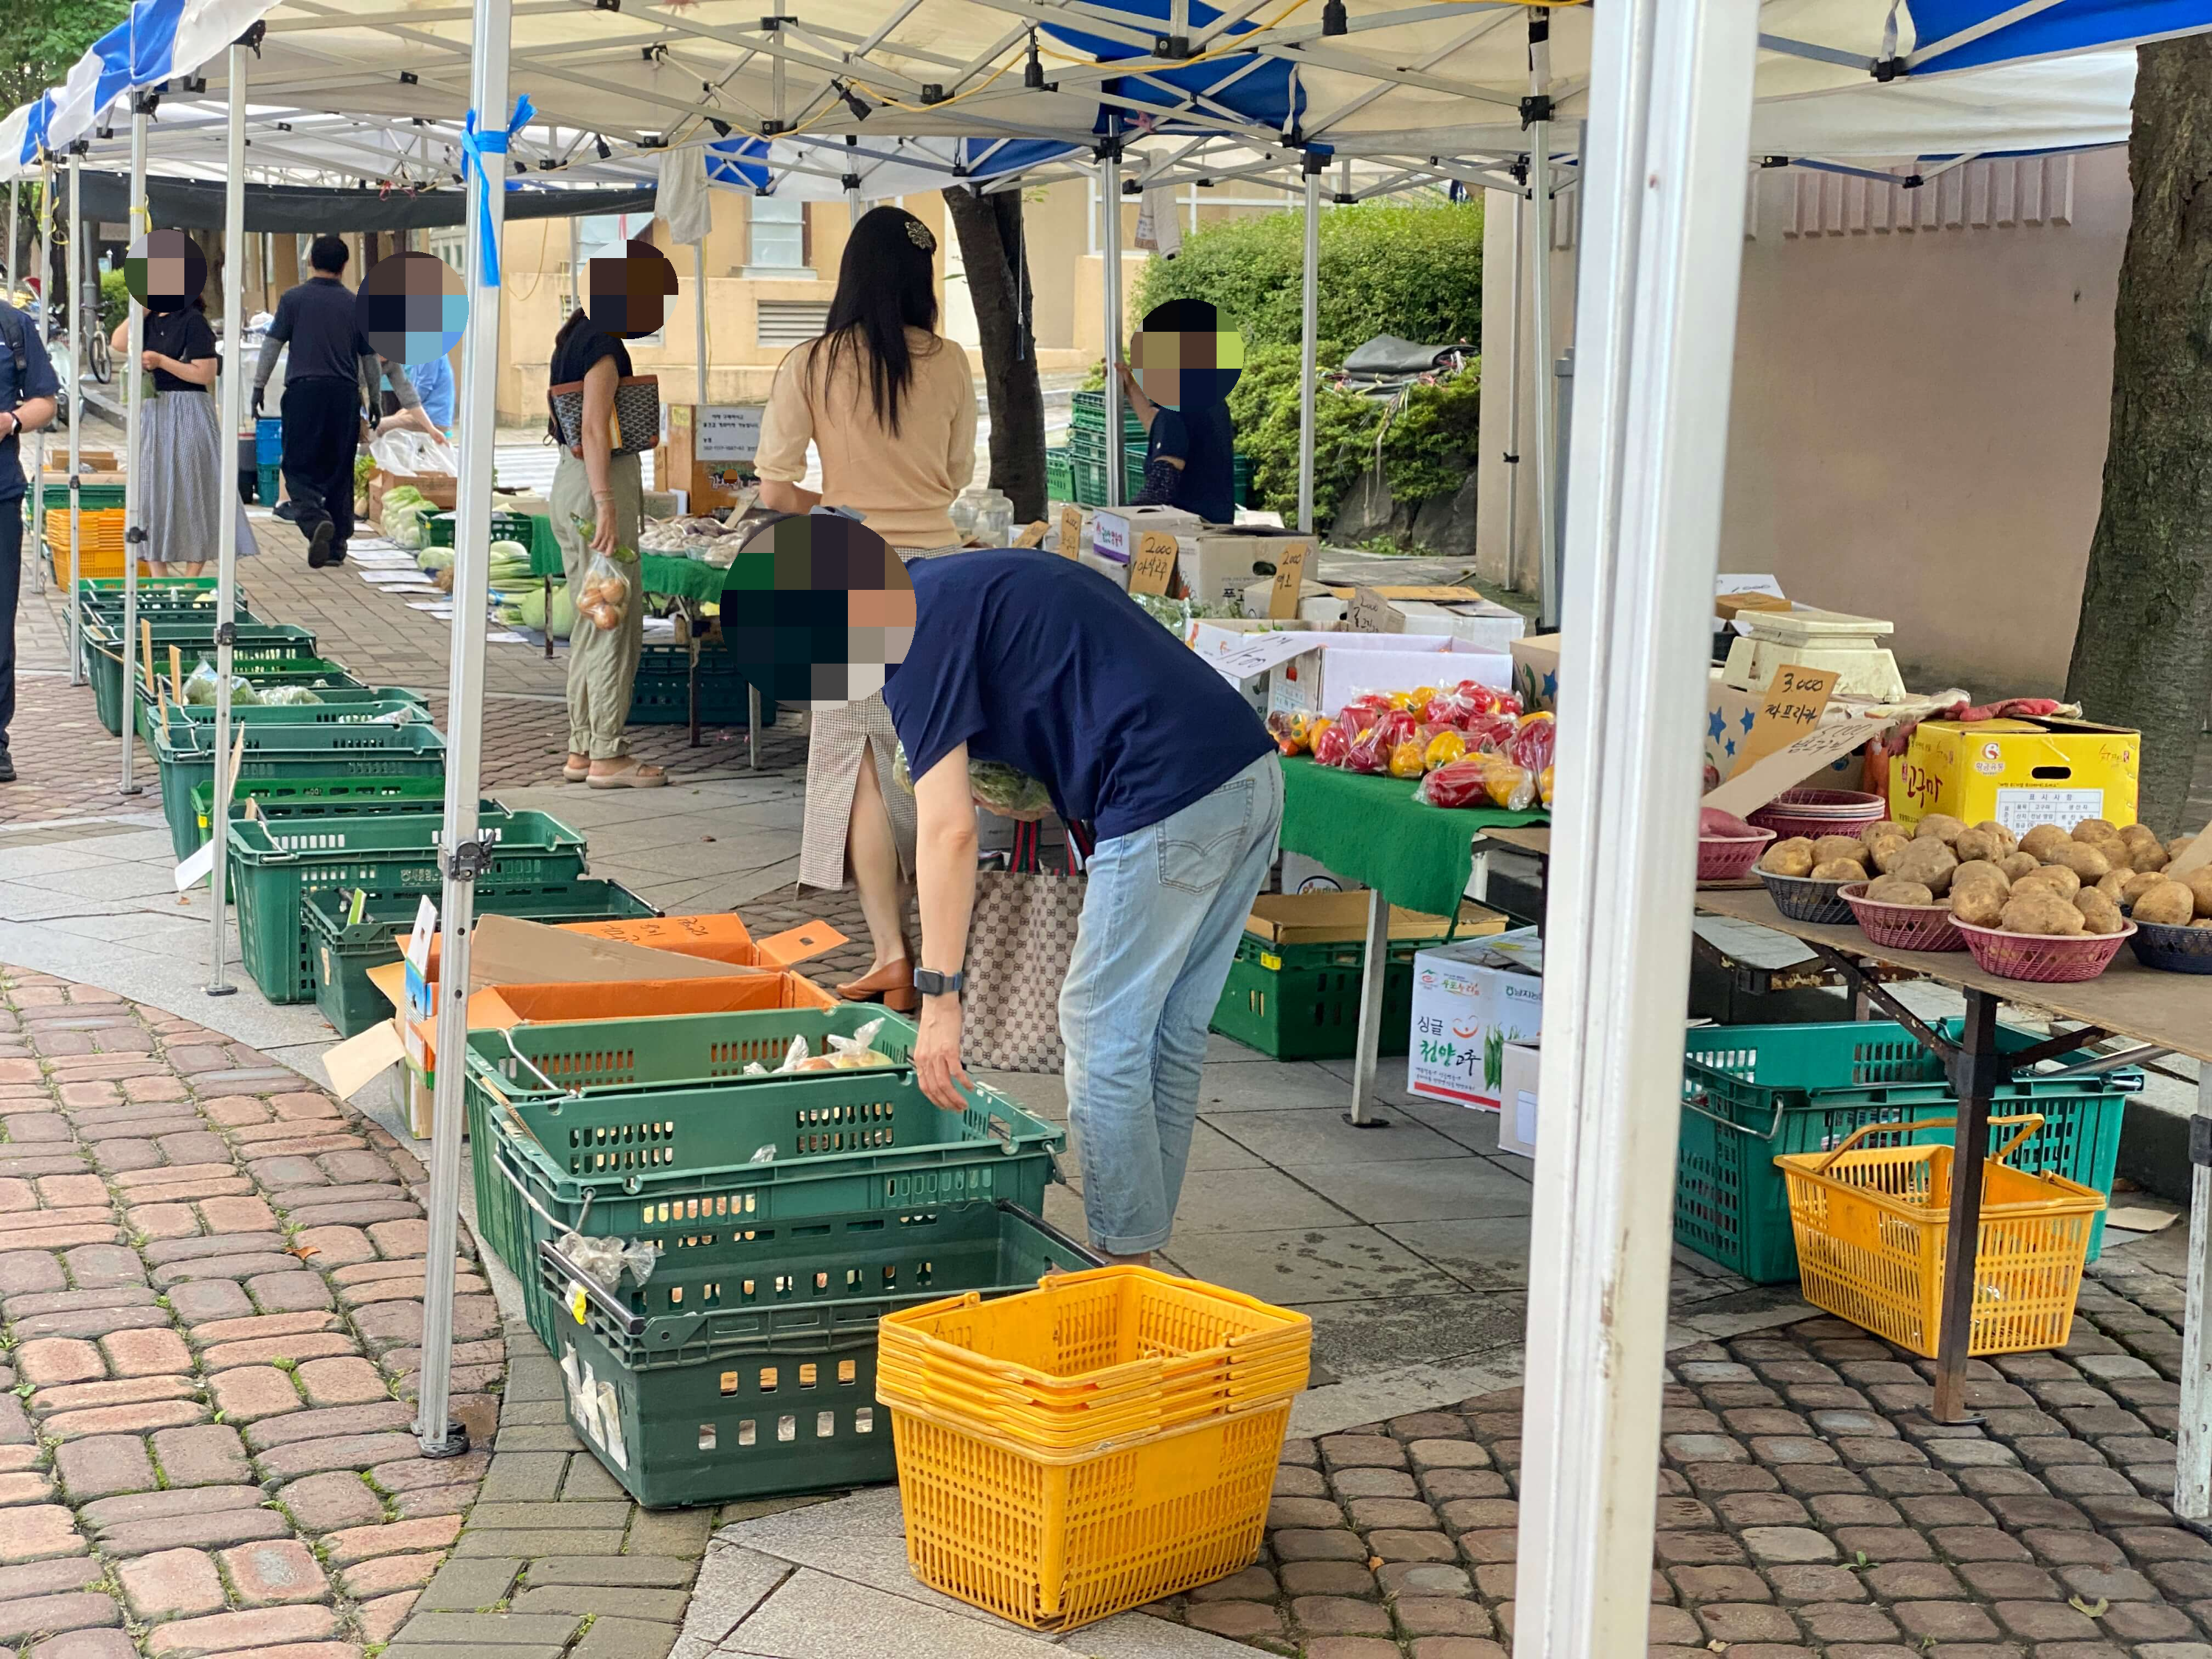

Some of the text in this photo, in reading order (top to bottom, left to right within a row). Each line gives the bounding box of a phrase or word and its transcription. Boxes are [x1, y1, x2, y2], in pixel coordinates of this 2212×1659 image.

[1145, 536, 1172, 555] 2000
[1282, 550, 1302, 566] 2000
[1765, 703, 1818, 725] 파프리카
[1975, 762, 2004, 772] 황금유통
[1907, 765, 1943, 809] 고구마
[1417, 1015, 1444, 1037] 싱글
